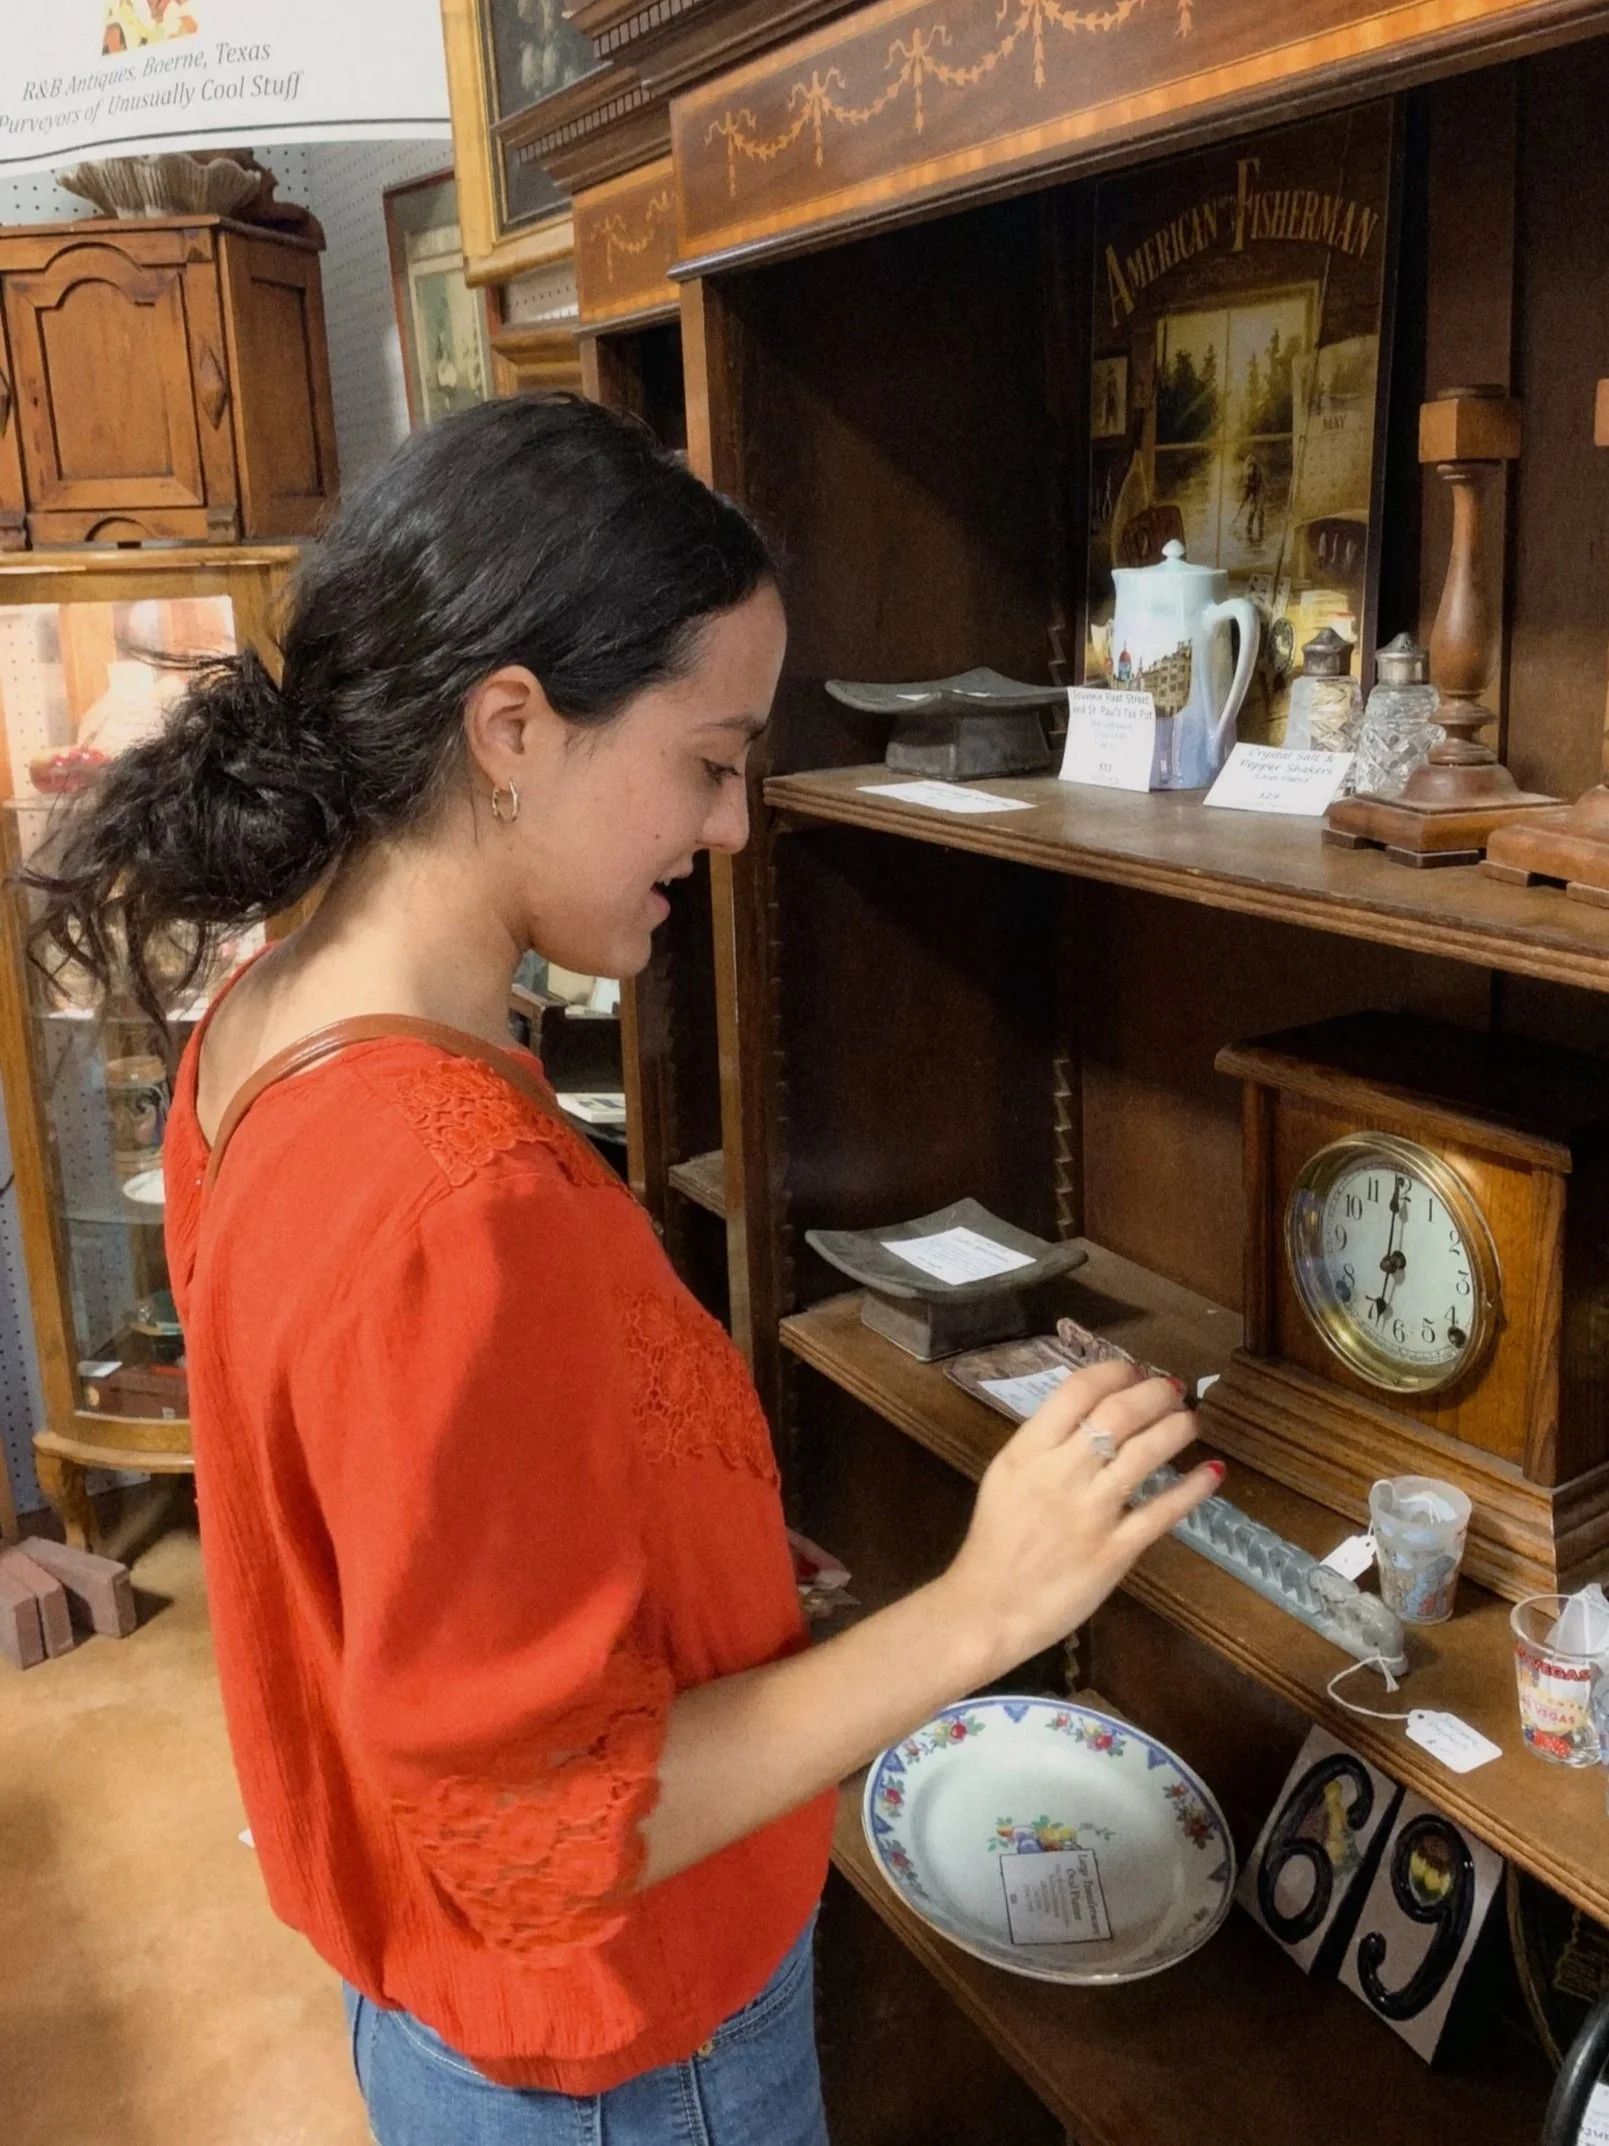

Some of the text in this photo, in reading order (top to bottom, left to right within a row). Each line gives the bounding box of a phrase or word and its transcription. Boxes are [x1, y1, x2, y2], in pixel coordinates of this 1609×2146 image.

[22, 78, 63, 101] R&B
[215, 41, 271, 64] Texas
[83, 101, 101, 126] of
[107, 82, 196, 116] Unusually
[200, 75, 245, 102] Cool
[250, 70, 305, 101] Stuff
[1105, 157, 1379, 328] AMERICAN FISHERMAN
[1249, 748, 1292, 761] Crystal
[1296, 752, 1320, 762] Salt
[1287, 764, 1332, 776] Shakers
[1367, 1176, 1380, 1204] 11
[1345, 1194, 1364, 1221] 10
[1335, 1225, 1348, 1250] 9
[1449, 1230, 1461, 1256] 2
[1342, 1263, 1356, 1289] 8
[1455, 1270, 1471, 1296] 3
[1392, 1318, 1406, 1344] 6
[1421, 1317, 1436, 1344] 5
[1532, 1657, 1592, 1682] VEGAS
[1535, 1703, 1576, 1725] VEGAS
[1258, 1753, 1373, 1945] 6
[1357, 1813, 1475, 2021] 9
